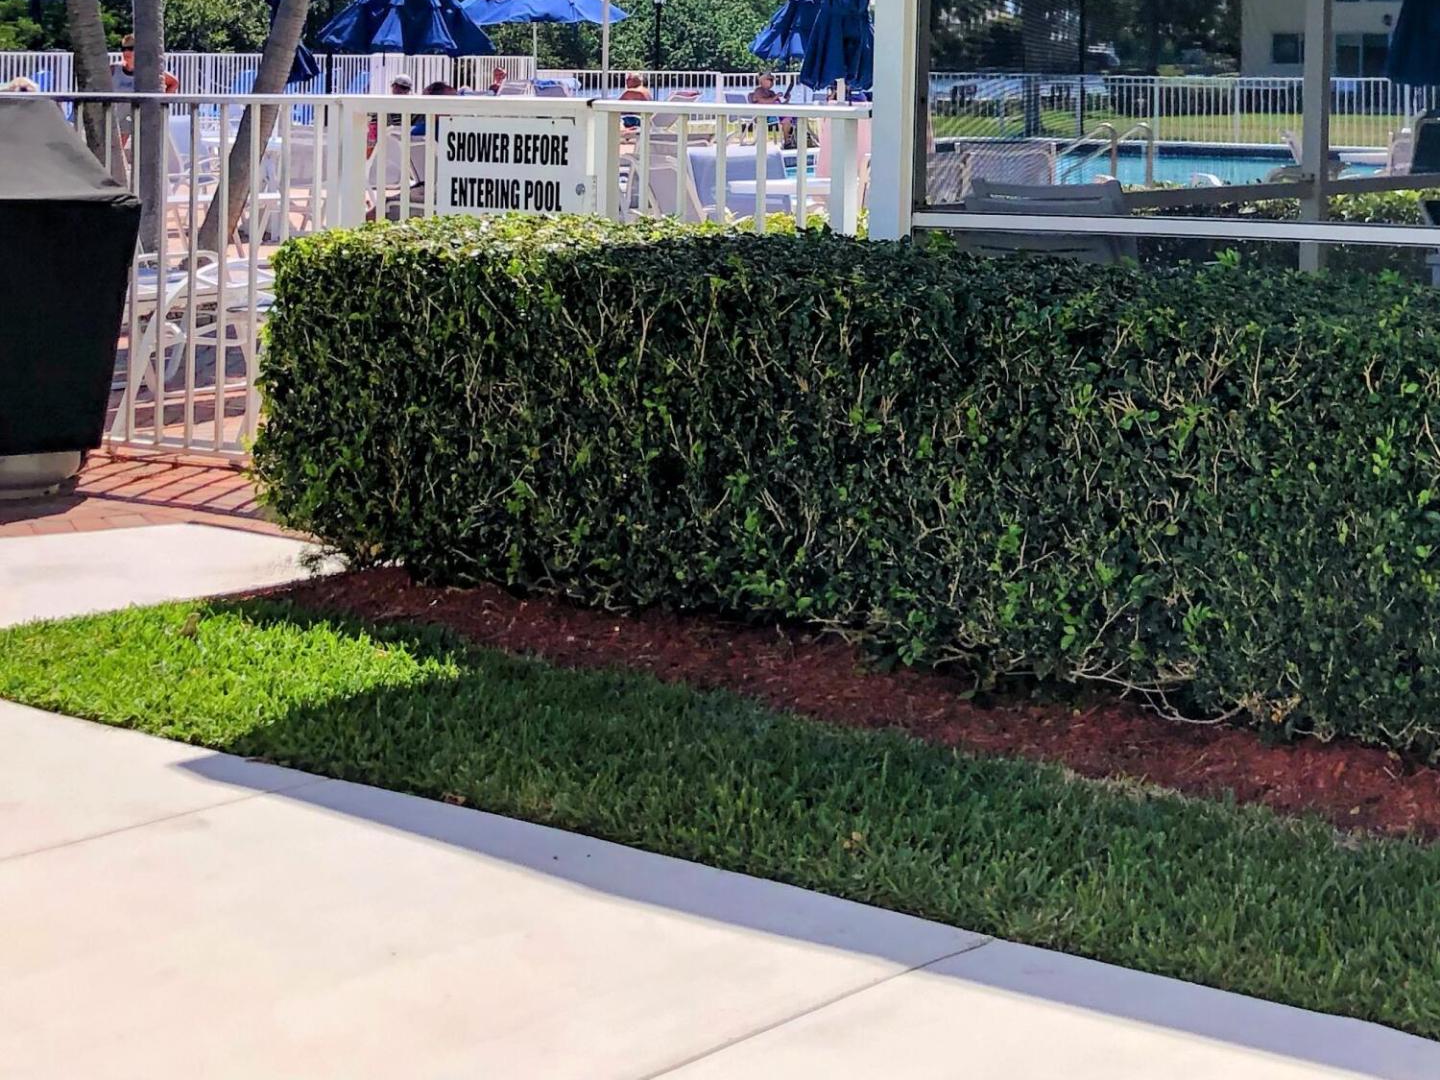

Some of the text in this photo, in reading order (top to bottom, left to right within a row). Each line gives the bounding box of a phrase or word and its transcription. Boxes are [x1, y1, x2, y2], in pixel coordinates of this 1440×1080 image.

[447, 131, 569, 166] SHOWER BEFORE
[451, 177, 562, 212] ENTERING POOL
